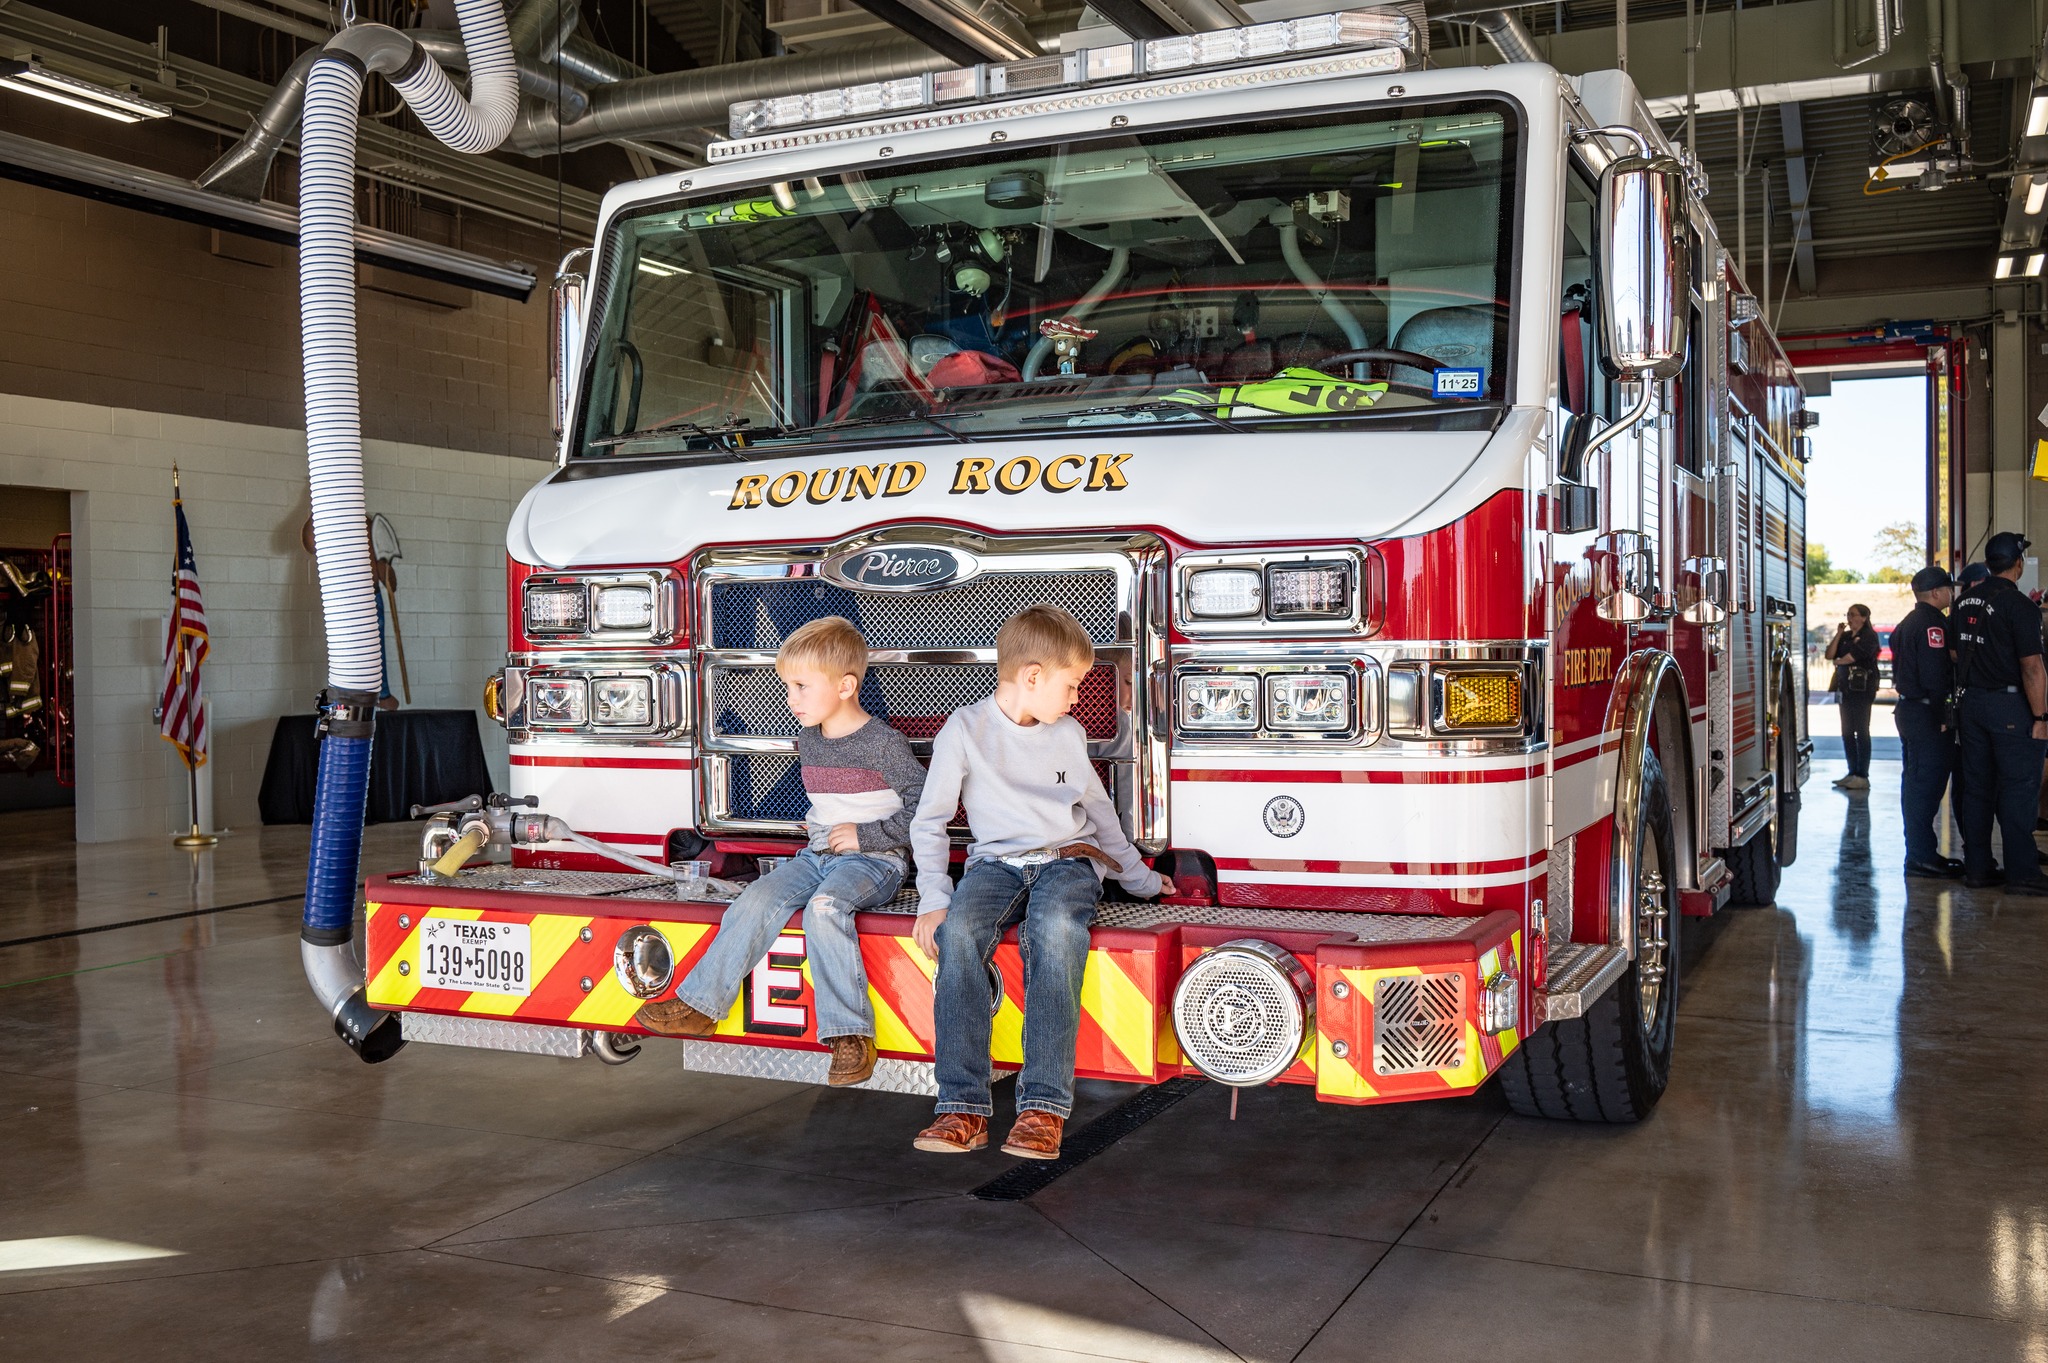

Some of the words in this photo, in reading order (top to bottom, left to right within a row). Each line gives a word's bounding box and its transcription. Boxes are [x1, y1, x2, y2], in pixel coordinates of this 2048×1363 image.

[1461, 379, 1477, 389] 25
[727, 461, 927, 510] ROUND
[948, 453, 1134, 495] ROCK
[856, 551, 942, 582] Pierce
[1564, 649, 1587, 689] FIRE
[453, 924, 496, 940] TEXAS
[461, 938, 488, 946] EXEMPT
[743, 932, 808, 1037] E
